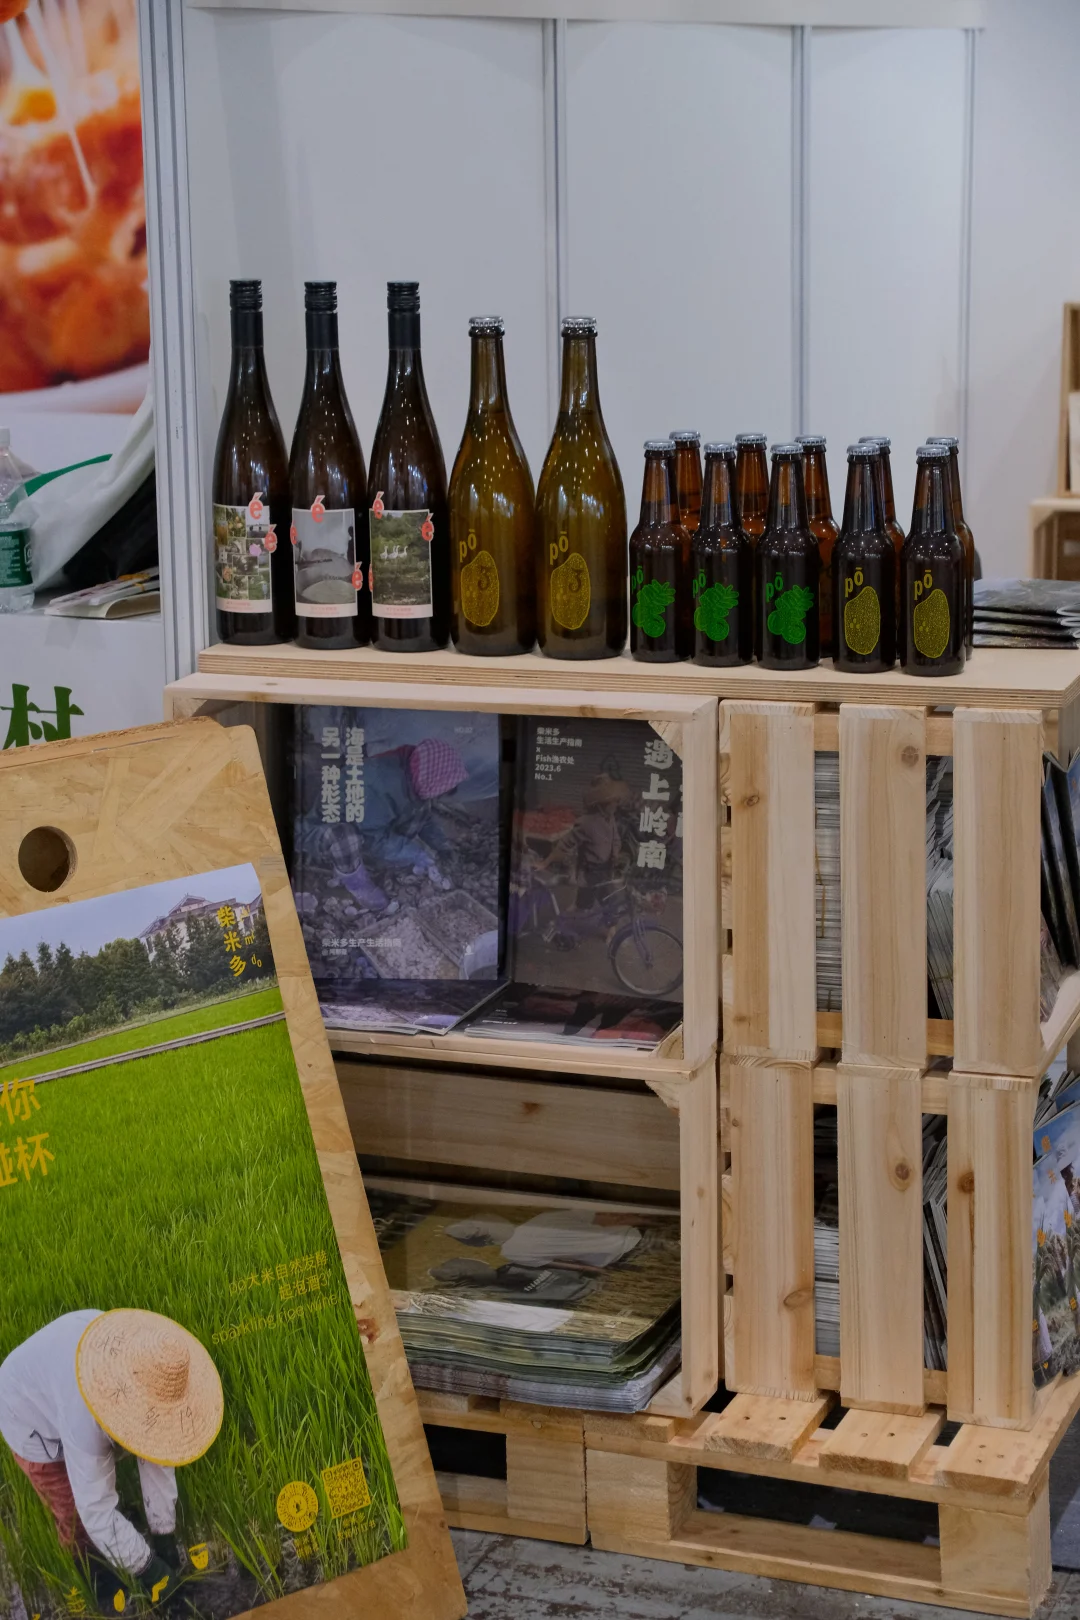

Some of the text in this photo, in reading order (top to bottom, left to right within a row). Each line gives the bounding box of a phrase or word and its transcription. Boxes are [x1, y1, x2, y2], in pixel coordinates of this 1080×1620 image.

[321, 727, 341, 823] 另一种形态
[345, 727, 365, 823] 海是土地的
[534, 772, 553, 781] No.1
[535, 763, 562, 773] 2023.6
[637, 739, 674, 870] 遇上岭南
[216, 904, 247, 978] 柴米多
